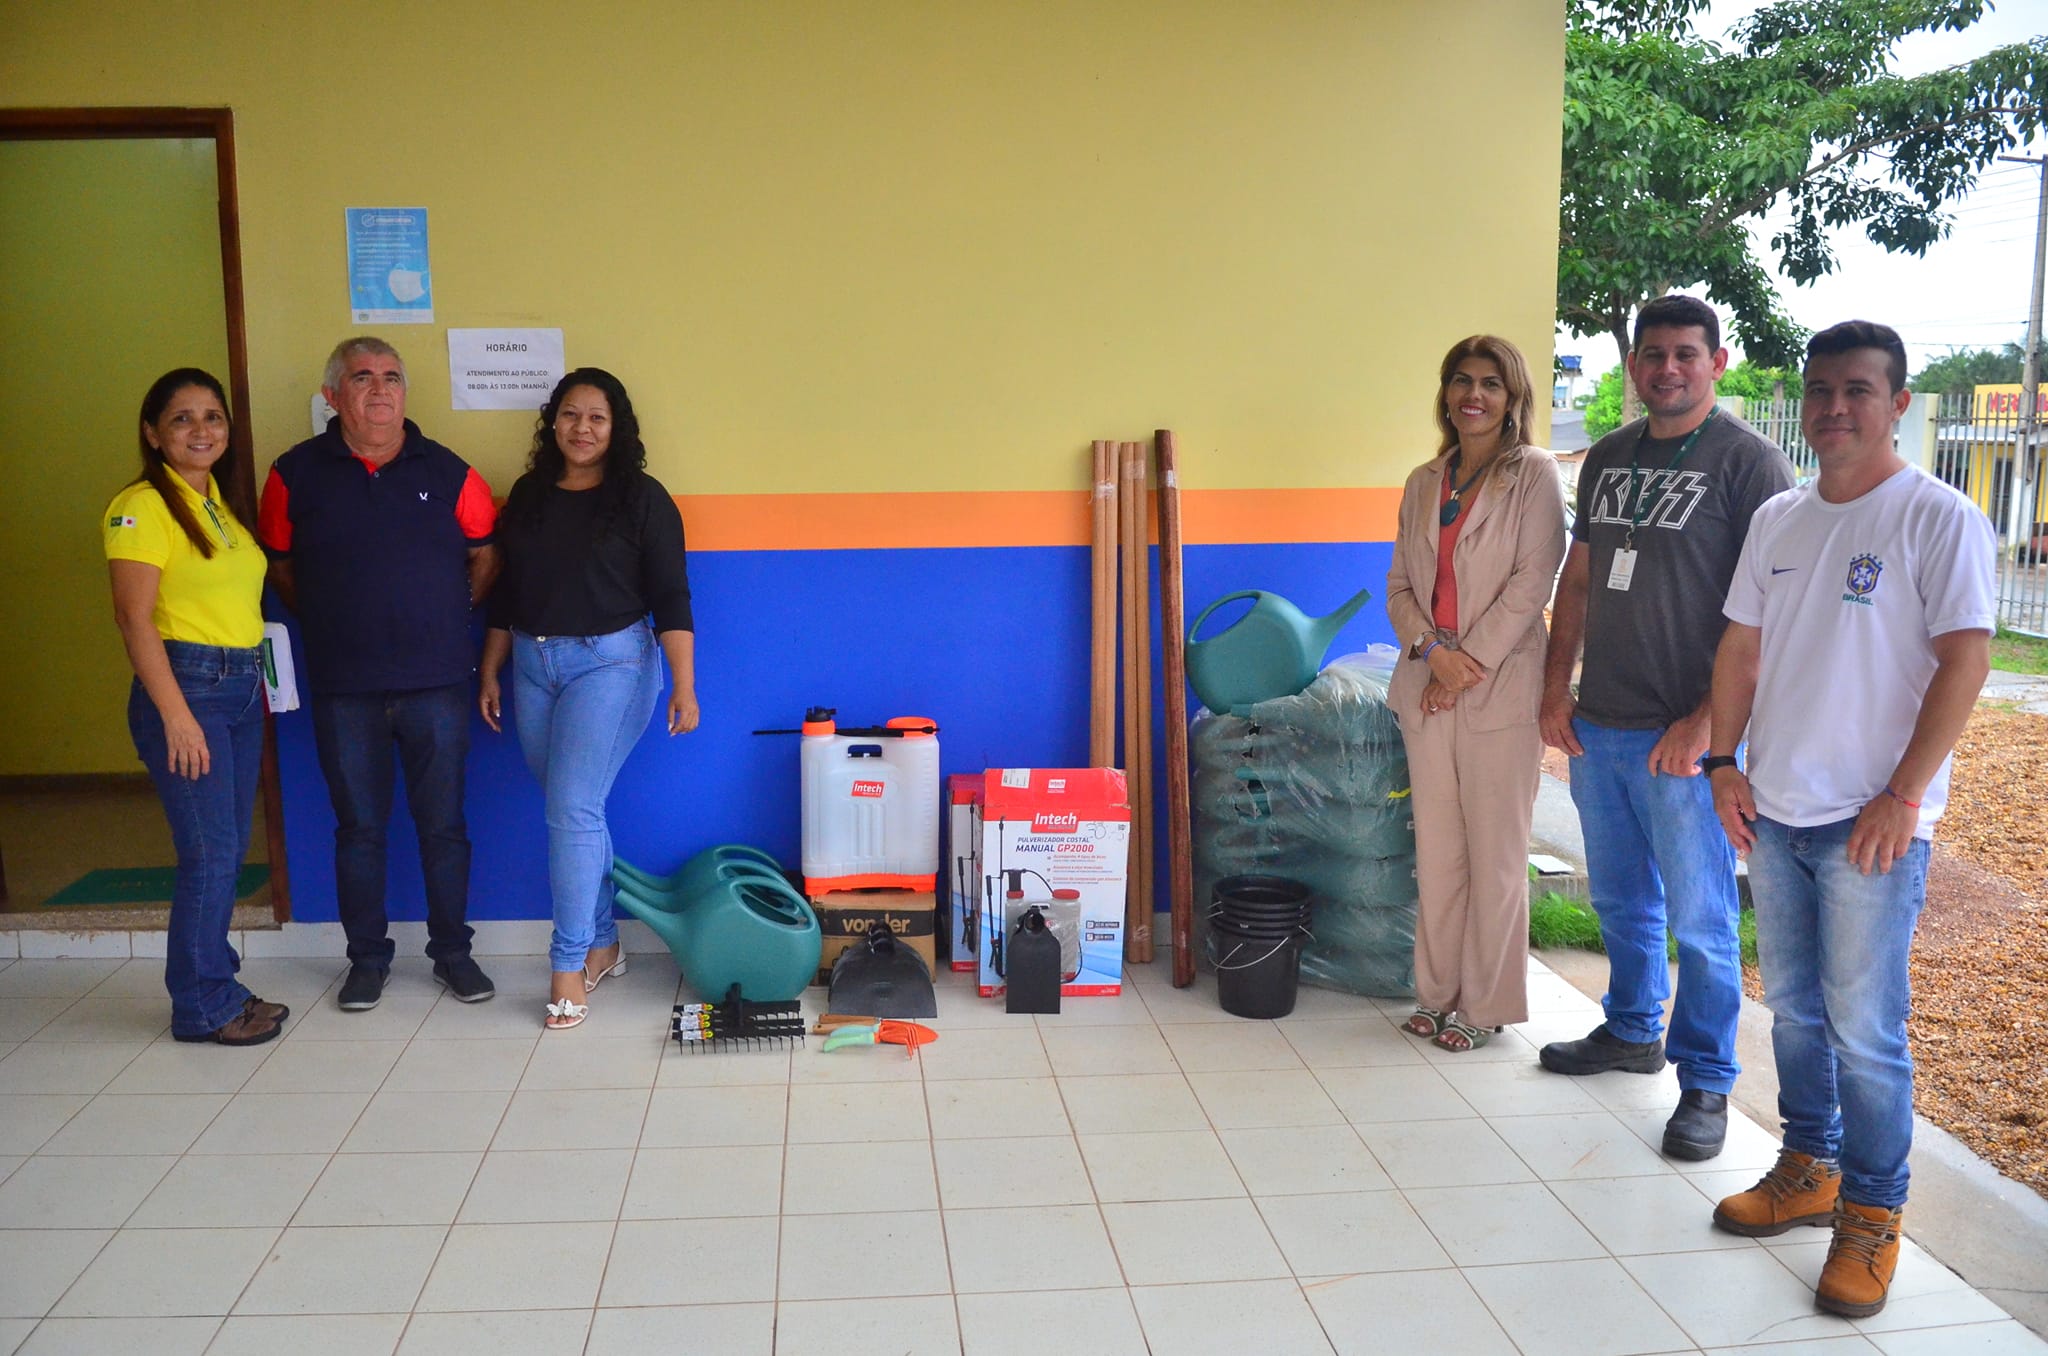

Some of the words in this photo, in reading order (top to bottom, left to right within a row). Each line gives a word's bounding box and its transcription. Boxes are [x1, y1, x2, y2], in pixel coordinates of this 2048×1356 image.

[486, 341, 528, 352] HORÁRIO
[521, 382, 550, 391] (MANHÃ)
[1589, 467, 1708, 530] KISS
[1842, 593, 1874, 606] BRASIL
[854, 783, 883, 793] Intech
[1035, 812, 1078, 825] Intech
[1015, 844, 1056, 853] MANUAL
[1056, 844, 1095, 853] GP2000
